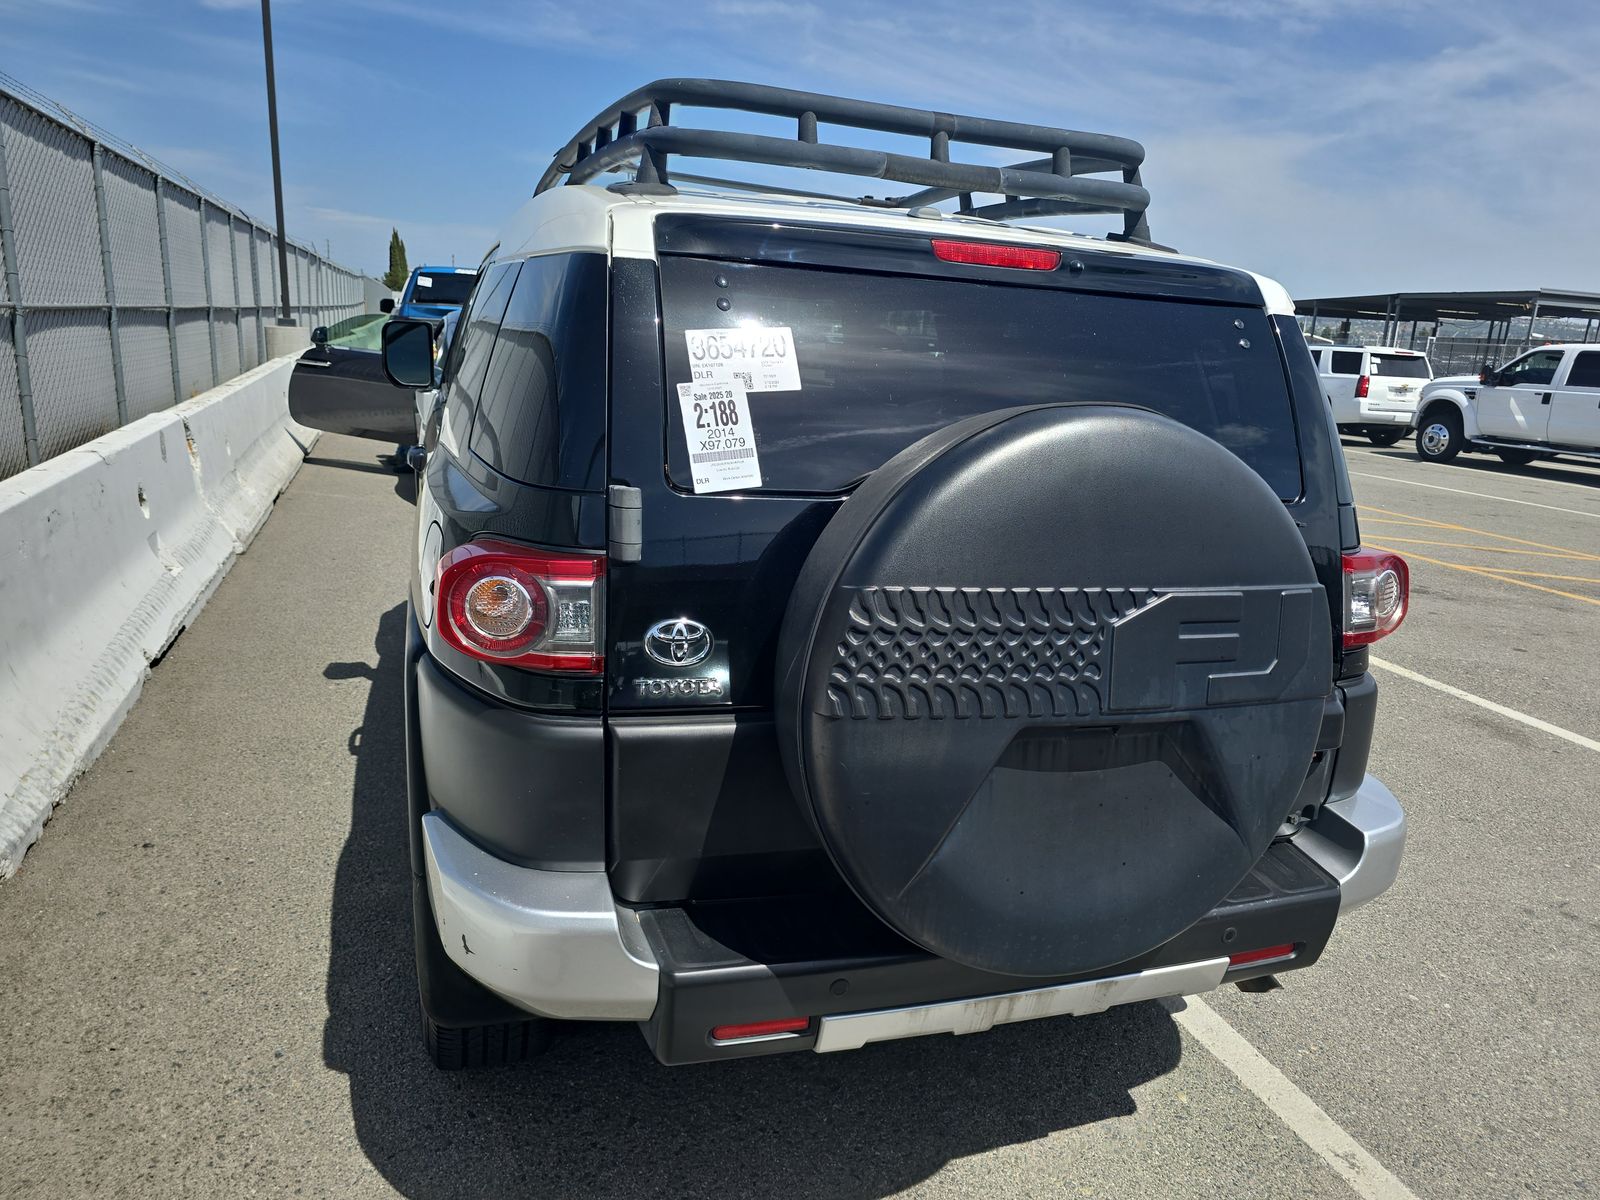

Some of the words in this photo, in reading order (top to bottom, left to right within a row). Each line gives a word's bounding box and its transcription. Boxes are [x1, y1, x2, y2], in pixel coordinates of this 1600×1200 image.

[693, 370, 714, 380] DLR
[693, 393, 708, 402] Sale
[709, 391, 724, 400] 2025
[725, 390, 733, 398] 20
[707, 427, 735, 440] 2014
[700, 437, 746, 452] X97,079
[696, 477, 710, 485] DLR
[632, 677, 724, 697] TOYOTA
